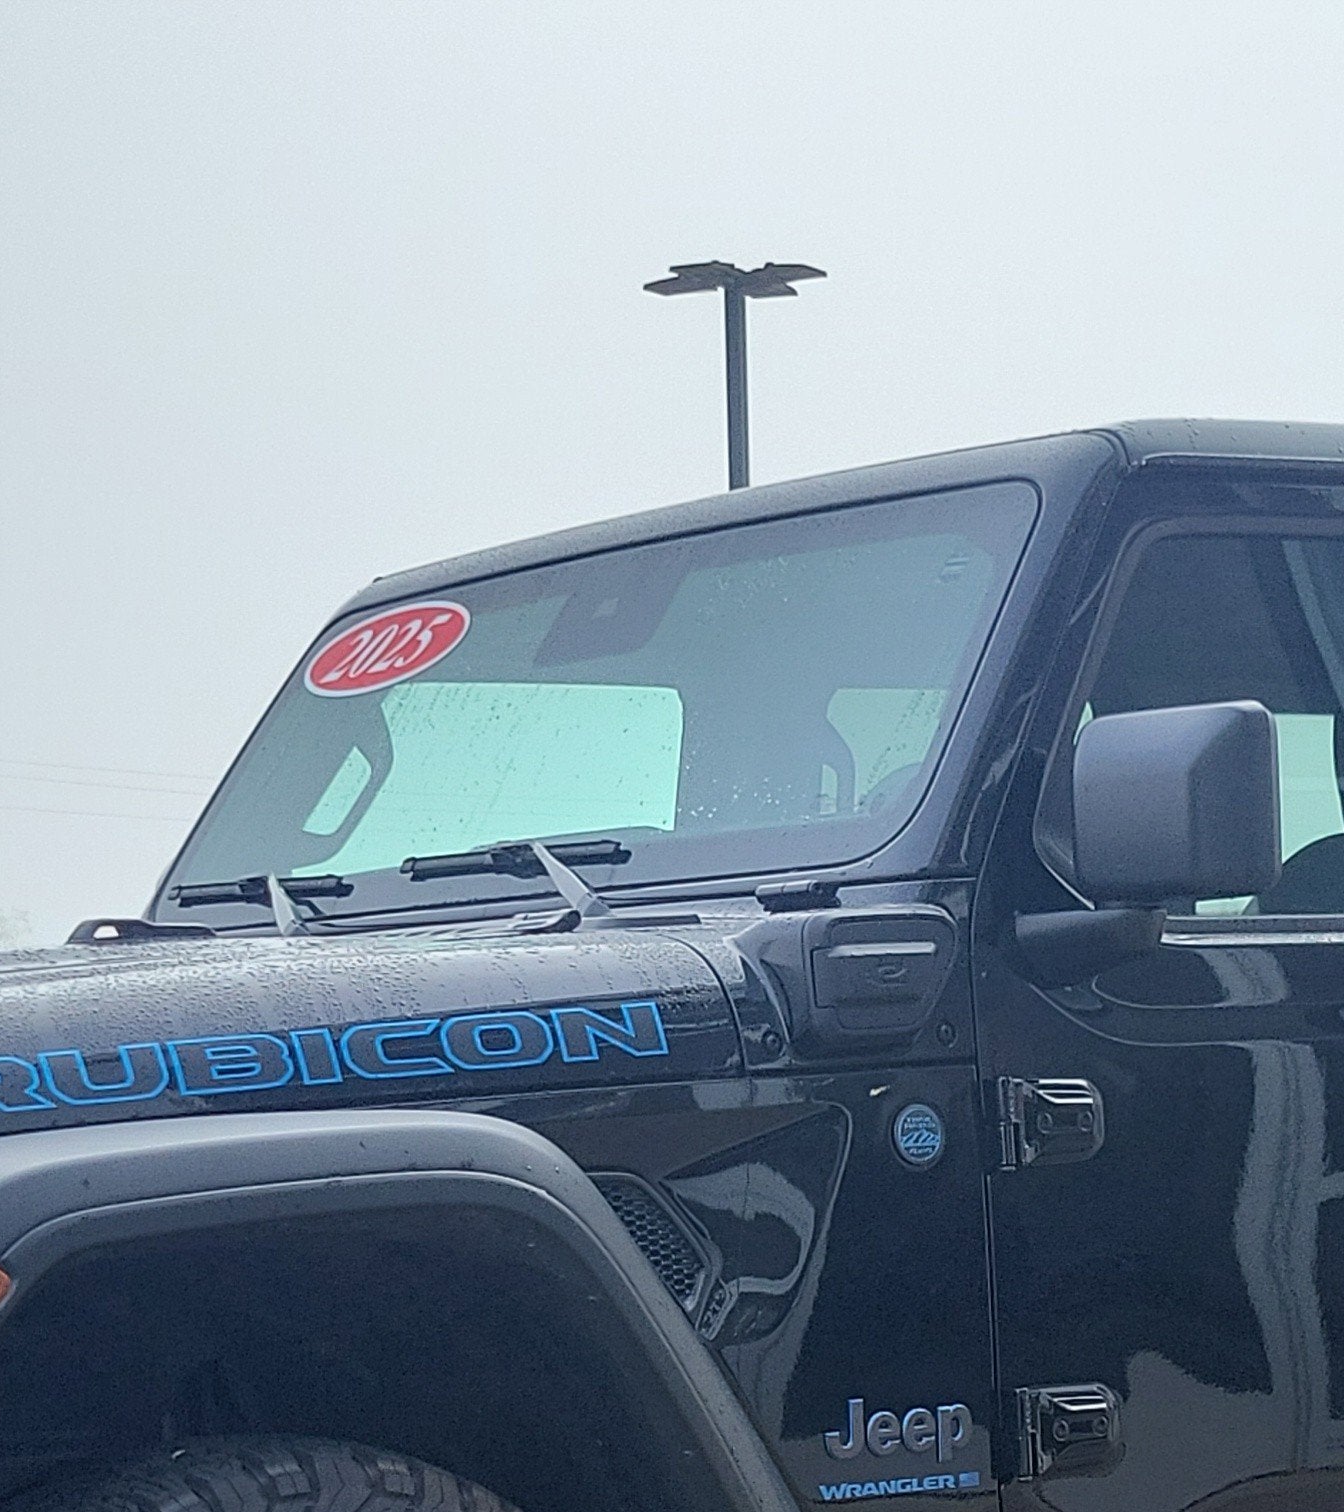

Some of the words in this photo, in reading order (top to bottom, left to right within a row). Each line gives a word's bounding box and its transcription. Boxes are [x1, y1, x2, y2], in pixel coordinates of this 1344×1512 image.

[317, 613, 454, 684] 2025
[823, 1397, 973, 1463] Jeep
[818, 1474, 957, 1501] WRANGLER
